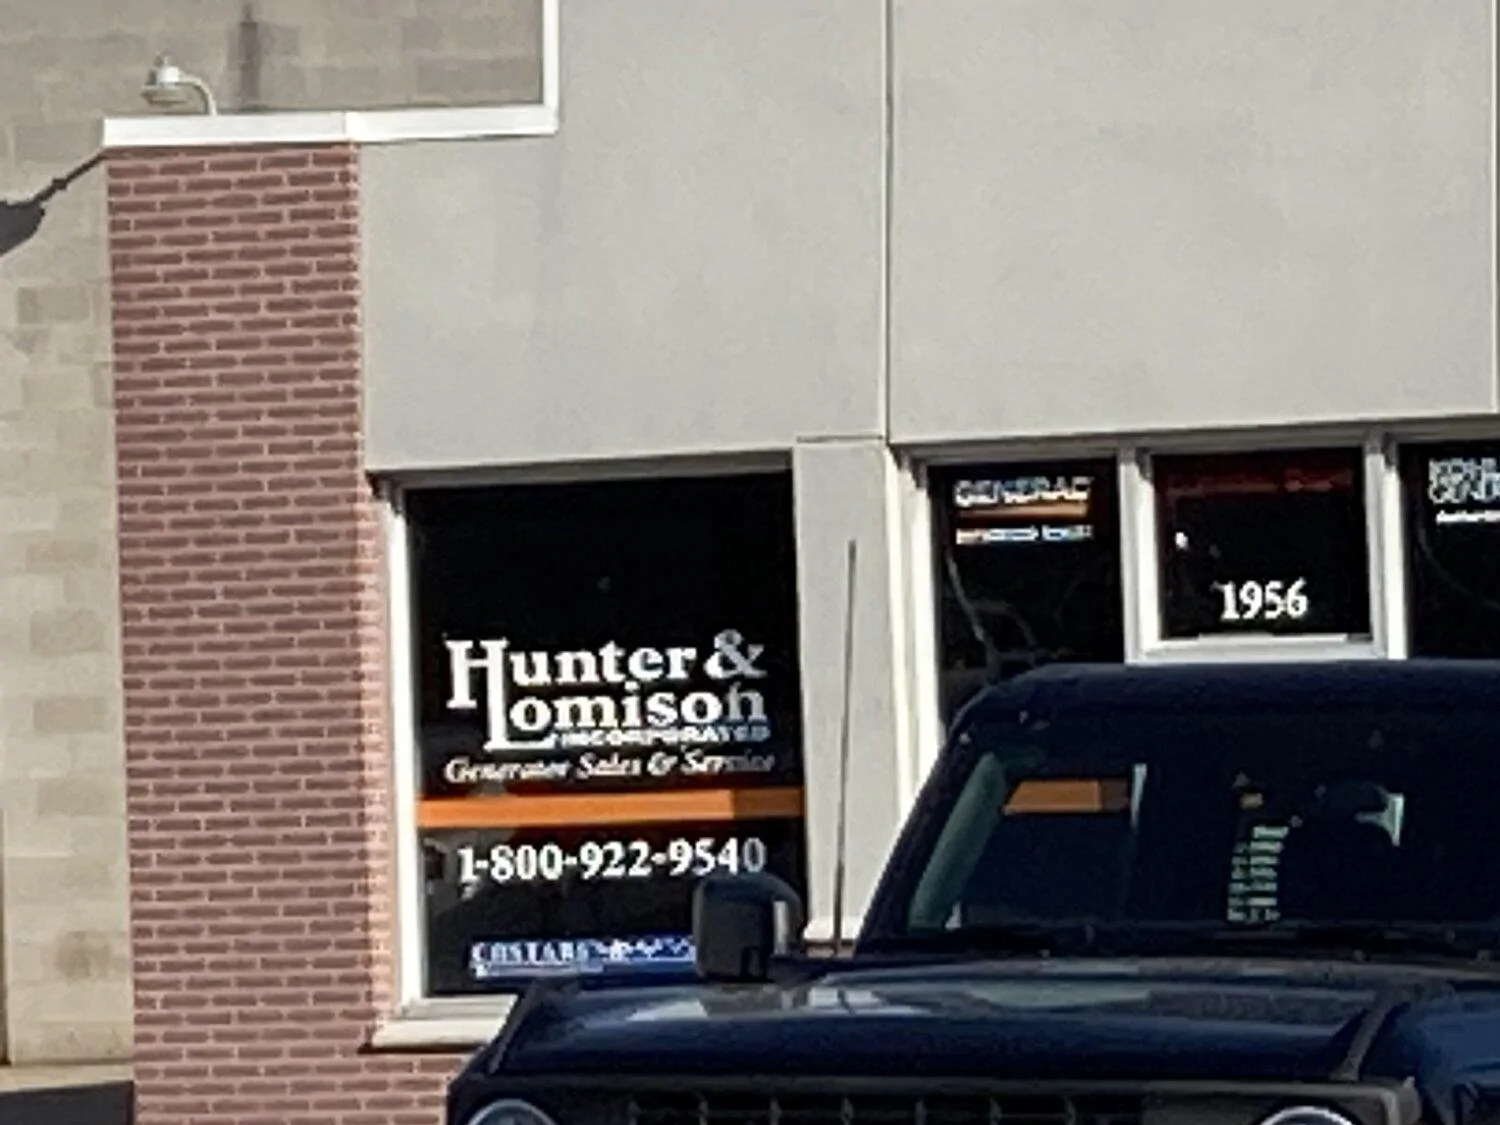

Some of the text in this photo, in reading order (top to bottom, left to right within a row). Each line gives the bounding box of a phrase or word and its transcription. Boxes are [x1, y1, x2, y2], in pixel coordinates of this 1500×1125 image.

[1220, 581, 1308, 622] 1956
[444, 630, 767, 708] Hunter &
[484, 682, 768, 752] Lomison
[458, 837, 767, 883] 1-800-922-9540
